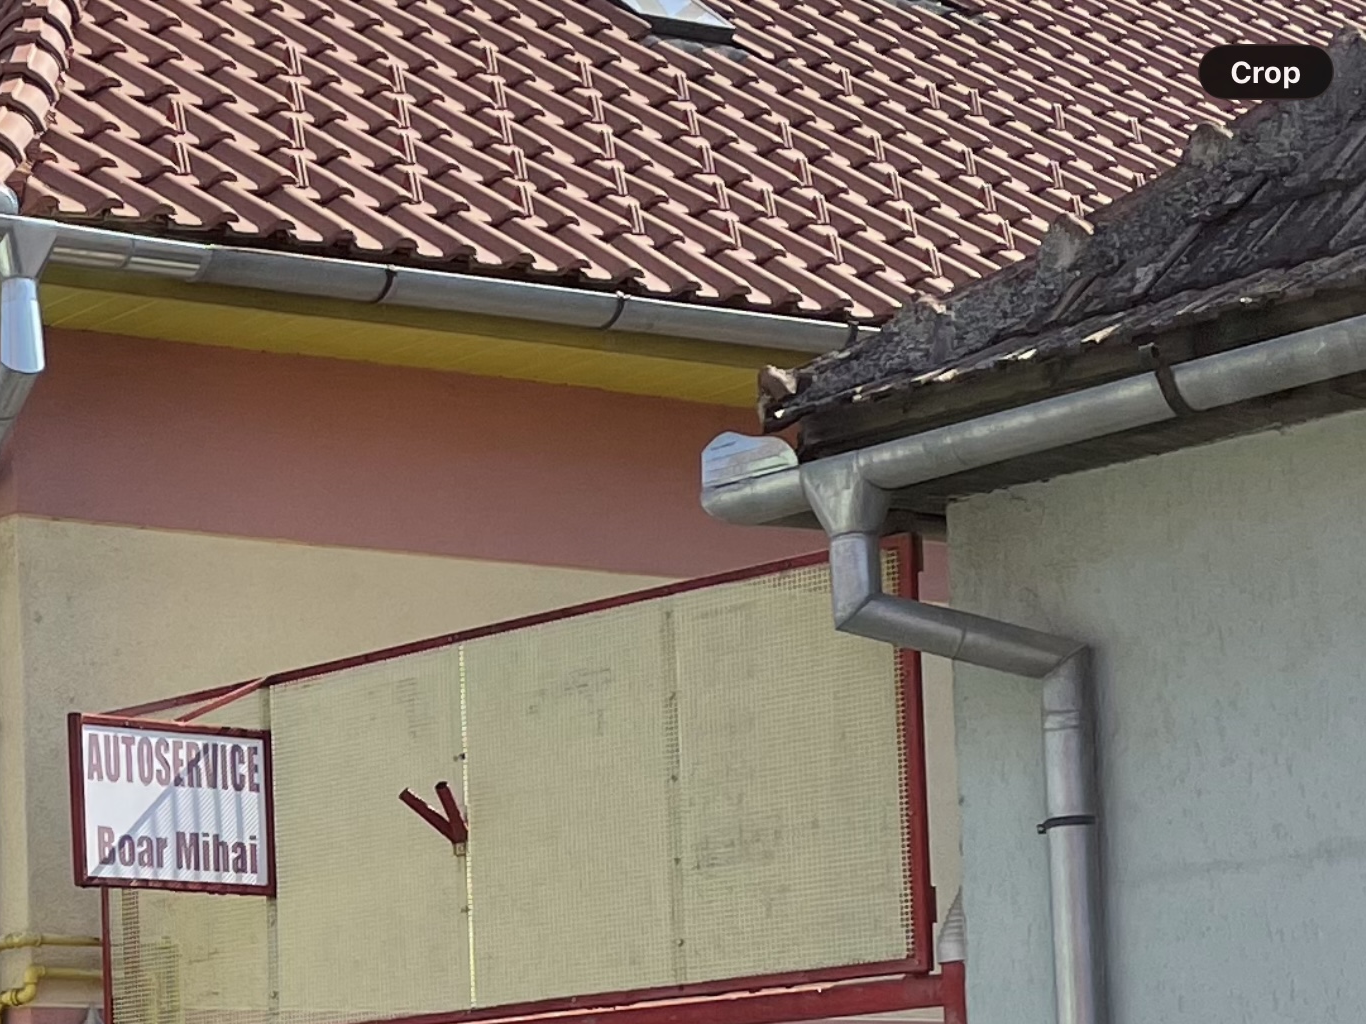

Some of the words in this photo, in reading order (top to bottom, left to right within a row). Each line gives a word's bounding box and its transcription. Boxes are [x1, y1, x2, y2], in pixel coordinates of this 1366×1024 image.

[87, 732, 261, 793] AUTOSERVICE
[97, 825, 169, 869] Boar
[175, 831, 258, 875] Mihai
